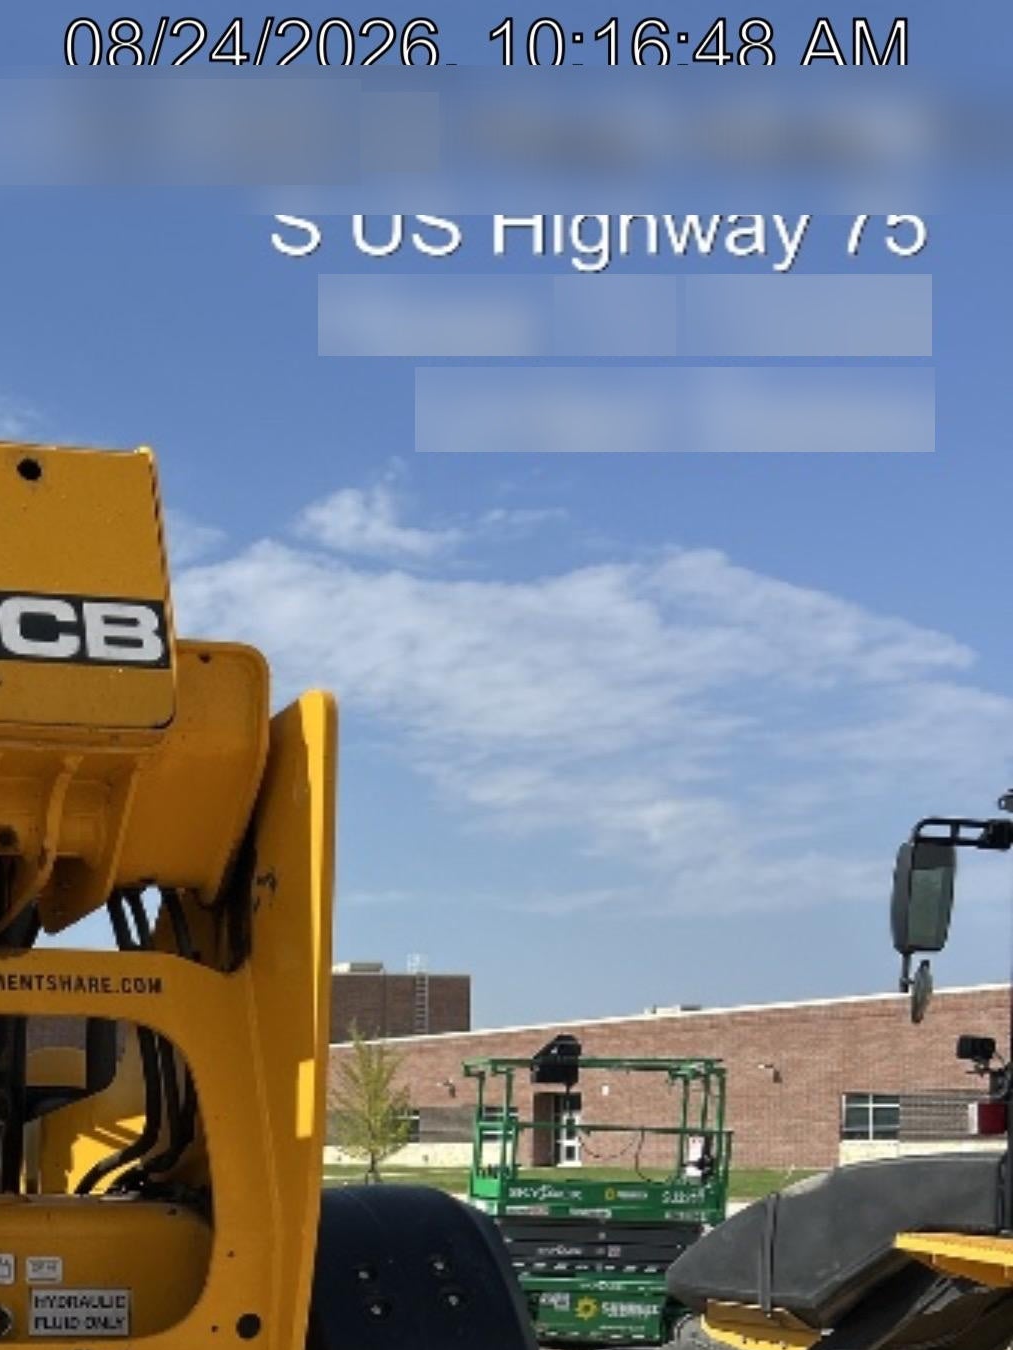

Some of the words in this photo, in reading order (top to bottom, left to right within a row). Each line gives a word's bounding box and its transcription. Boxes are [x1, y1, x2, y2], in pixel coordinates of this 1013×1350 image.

[34, 1295, 126, 1309] HYDRAULIC
[34, 1316, 80, 1330] FLUID
[84, 1316, 126, 1330] ONLY
